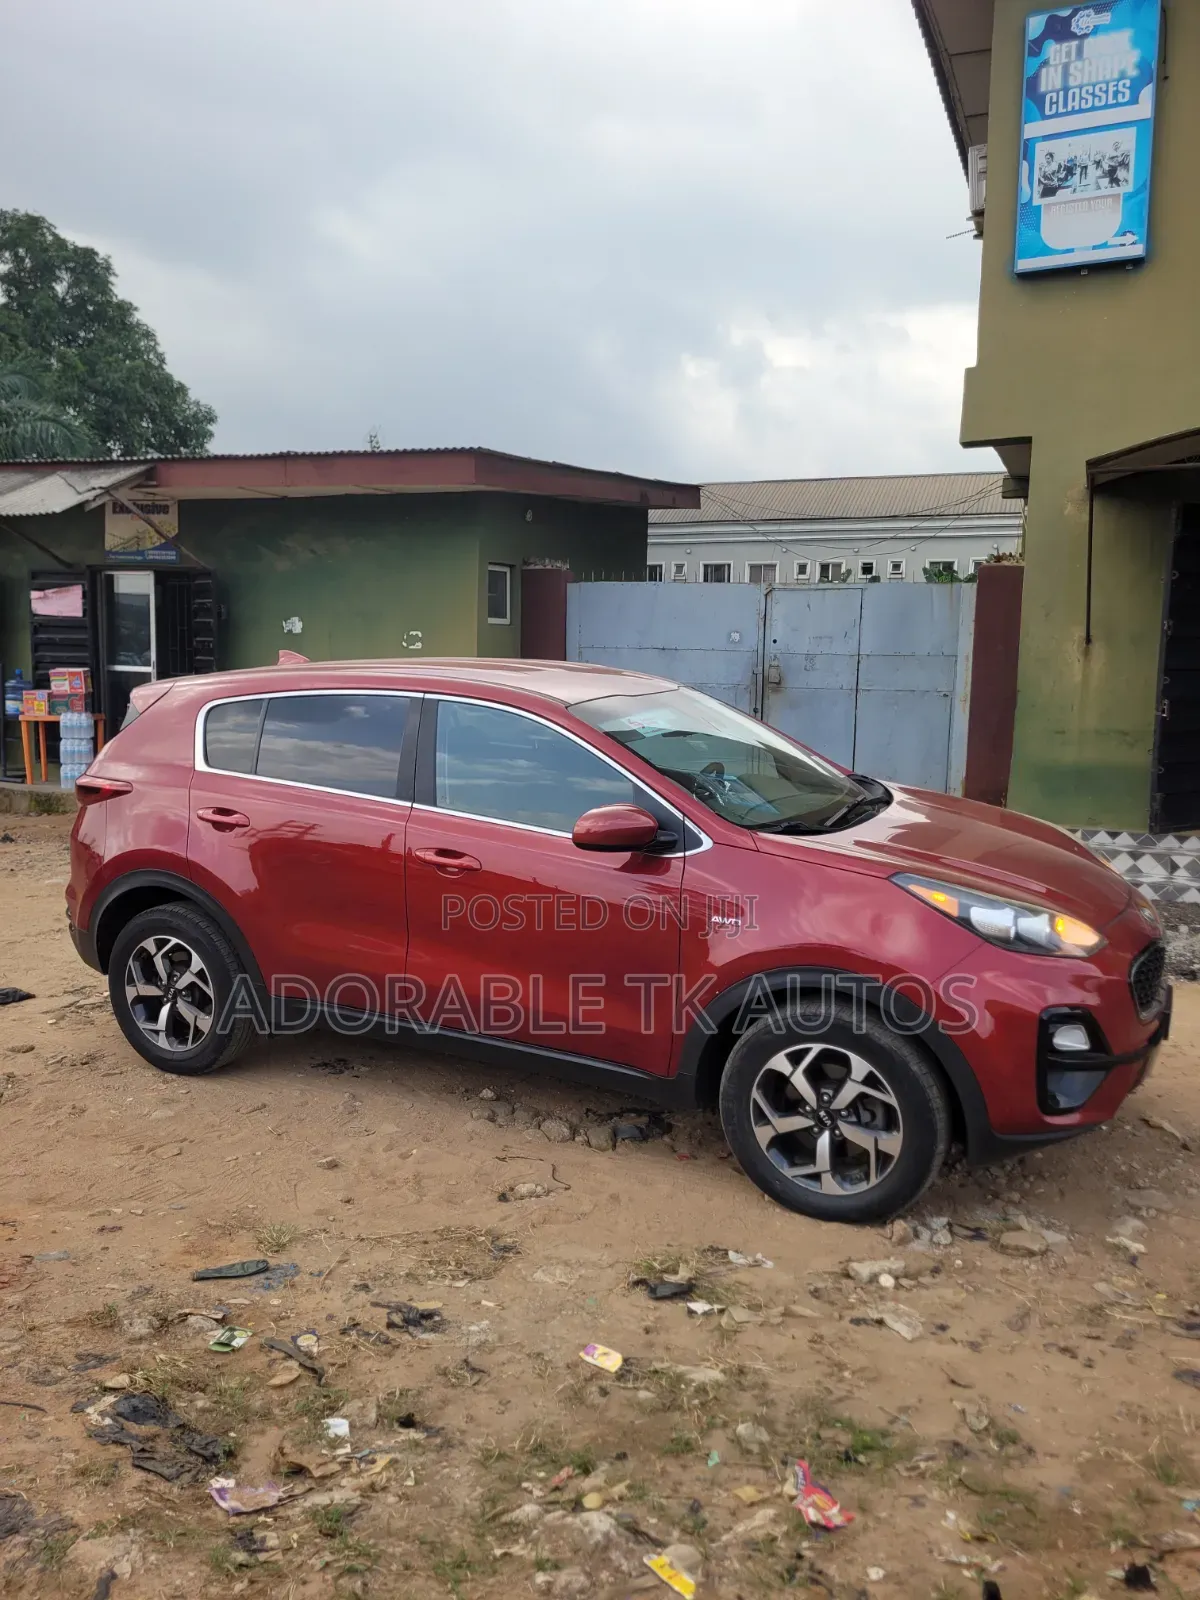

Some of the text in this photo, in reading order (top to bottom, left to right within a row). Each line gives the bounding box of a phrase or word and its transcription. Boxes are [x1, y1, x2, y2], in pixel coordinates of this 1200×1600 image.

[1049, 41, 1079, 65] GET
[1039, 64, 1062, 92] IN
[1044, 79, 1132, 116] CLASSES
[711, 915, 742, 926] AWD
[818, 1110, 832, 1127] KIA
